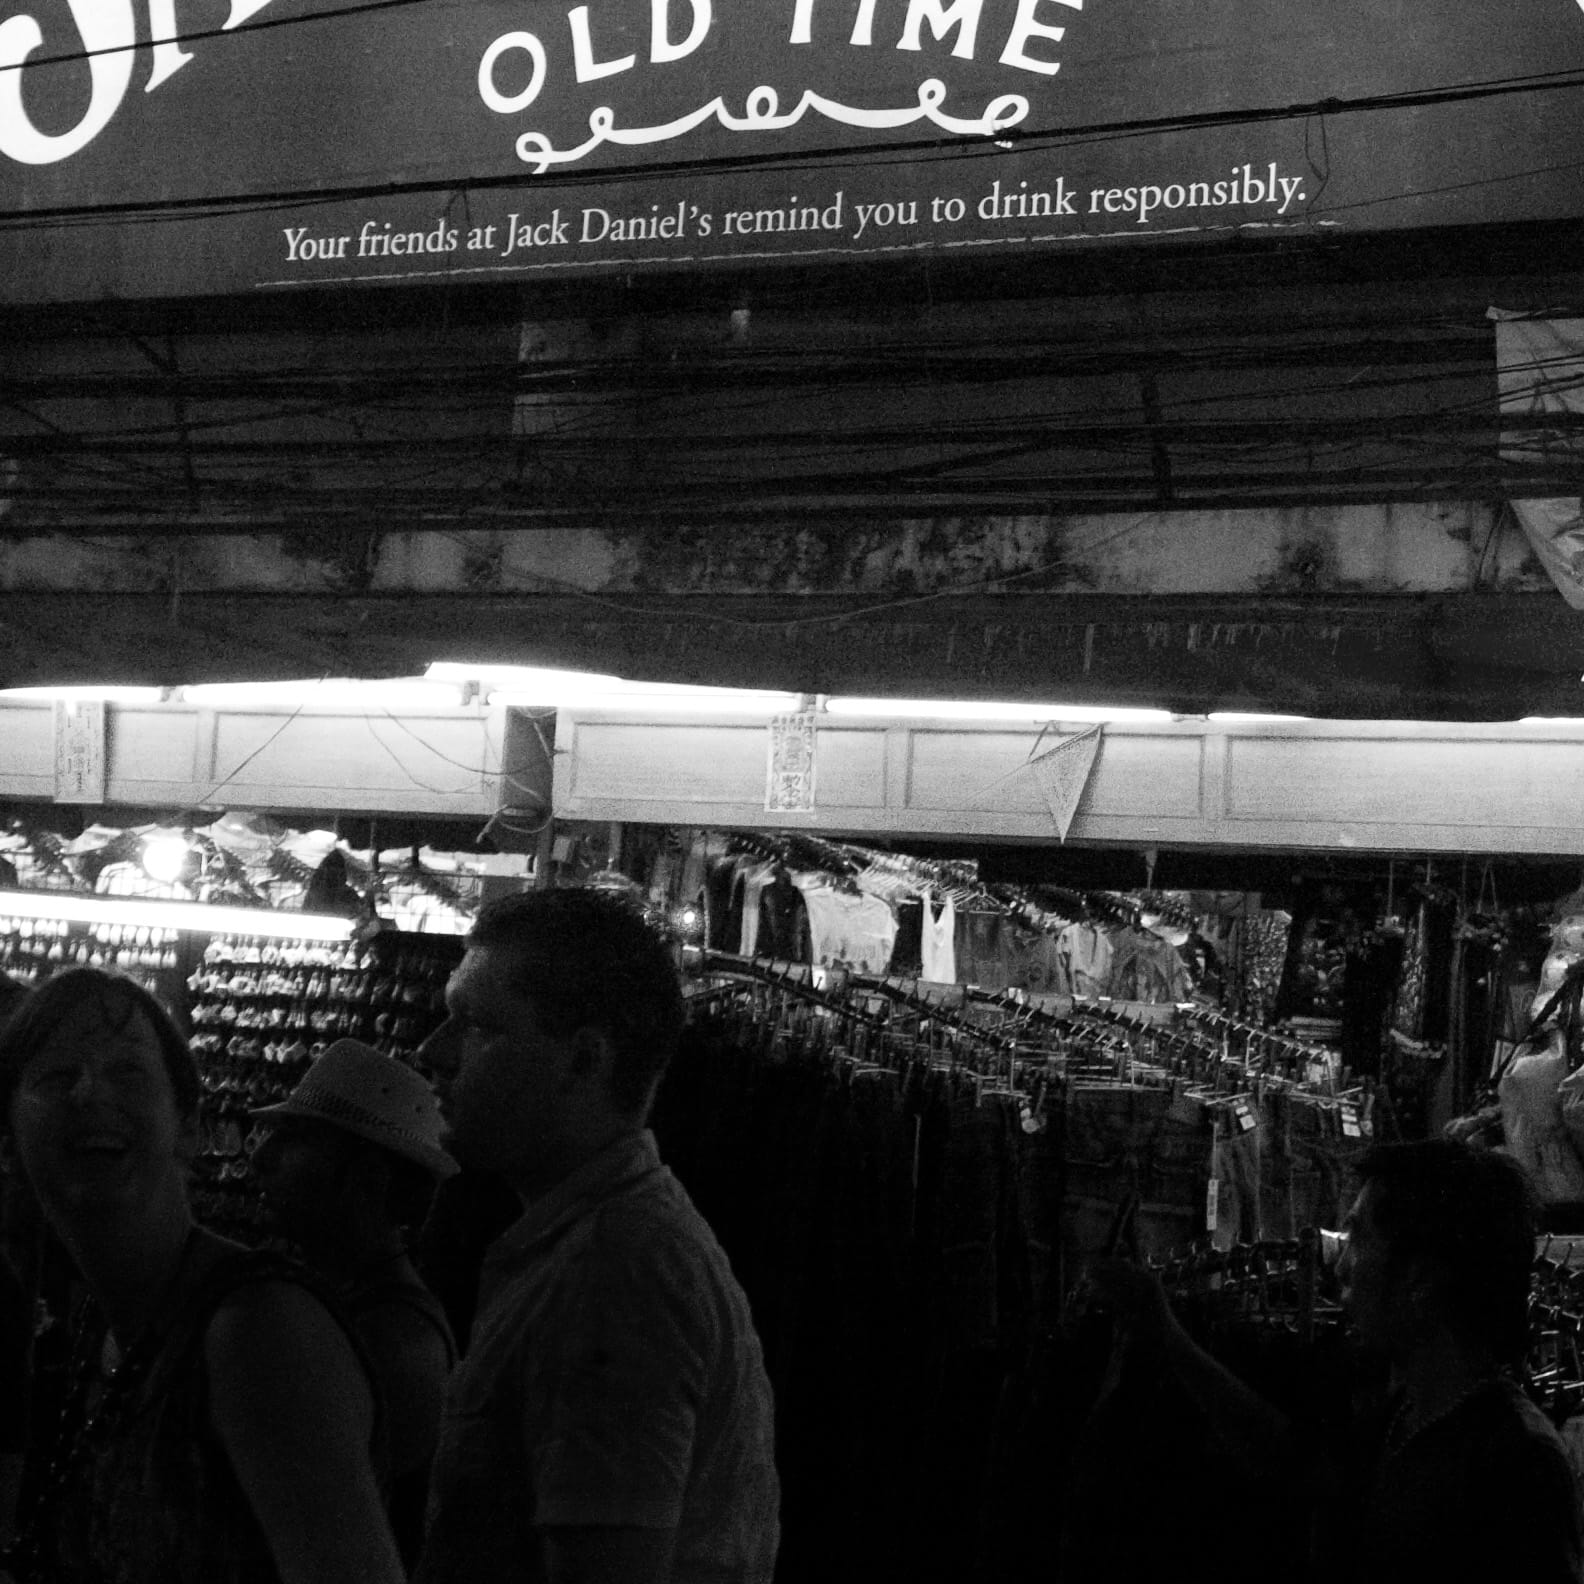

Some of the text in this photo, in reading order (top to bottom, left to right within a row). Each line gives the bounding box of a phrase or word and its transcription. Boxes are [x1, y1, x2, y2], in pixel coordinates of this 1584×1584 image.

[282, 162, 1308, 262] Your friends at Jack Daniel's remind you to drink responsibly.
